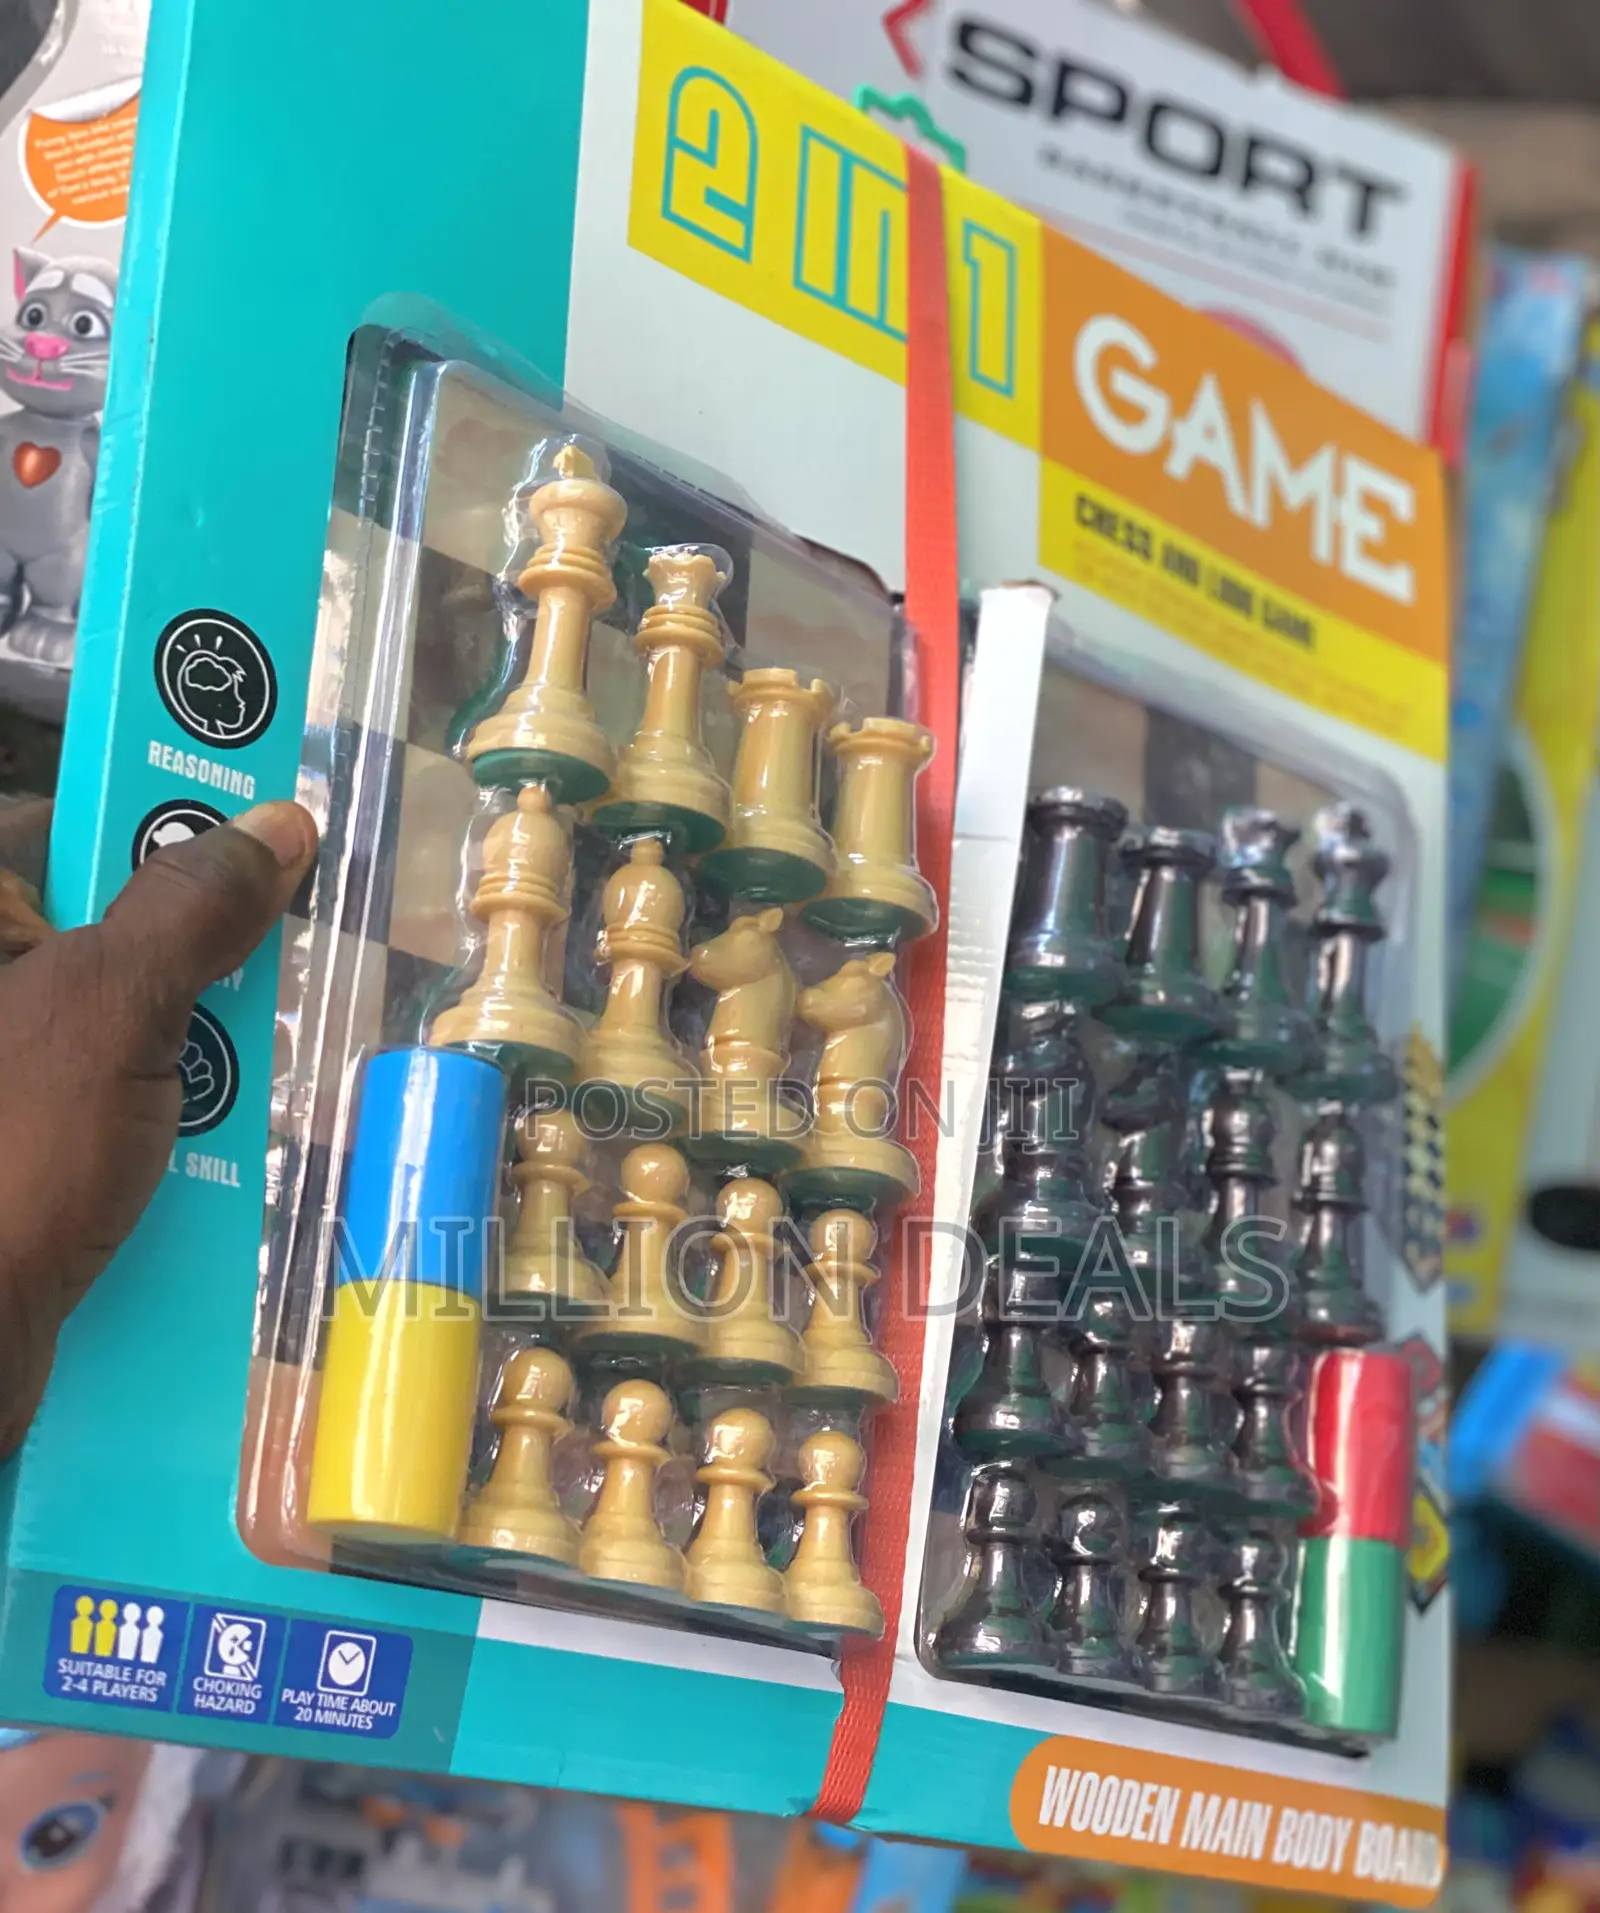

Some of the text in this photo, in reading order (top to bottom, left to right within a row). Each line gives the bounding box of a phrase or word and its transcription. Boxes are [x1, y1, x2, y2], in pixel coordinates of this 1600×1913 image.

[946, 16, 1408, 240] SPORT
[661, 65, 758, 264] 2
[963, 217, 1018, 400] 1
[1073, 312, 1416, 605] GAME
[1074, 493, 1154, 564] CHESS
[148, 739, 256, 801] REASONING
[185, 1151, 242, 1189] SKILL
[58, 1658, 168, 1687] SUITABLE FOR
[193, 1676, 263, 1699] CHOKING
[61, 1676, 160, 1703] 2-4 PLAYERS
[194, 1693, 256, 1715] HAZARD
[281, 1688, 397, 1717] PLAY TIME ABOUT
[293, 1705, 374, 1730] 20 MINUTES
[1038, 1765, 1182, 1846] WOODEN
[1180, 1791, 1273, 1862] MAIN
[1272, 1806, 1354, 1875] BODY
